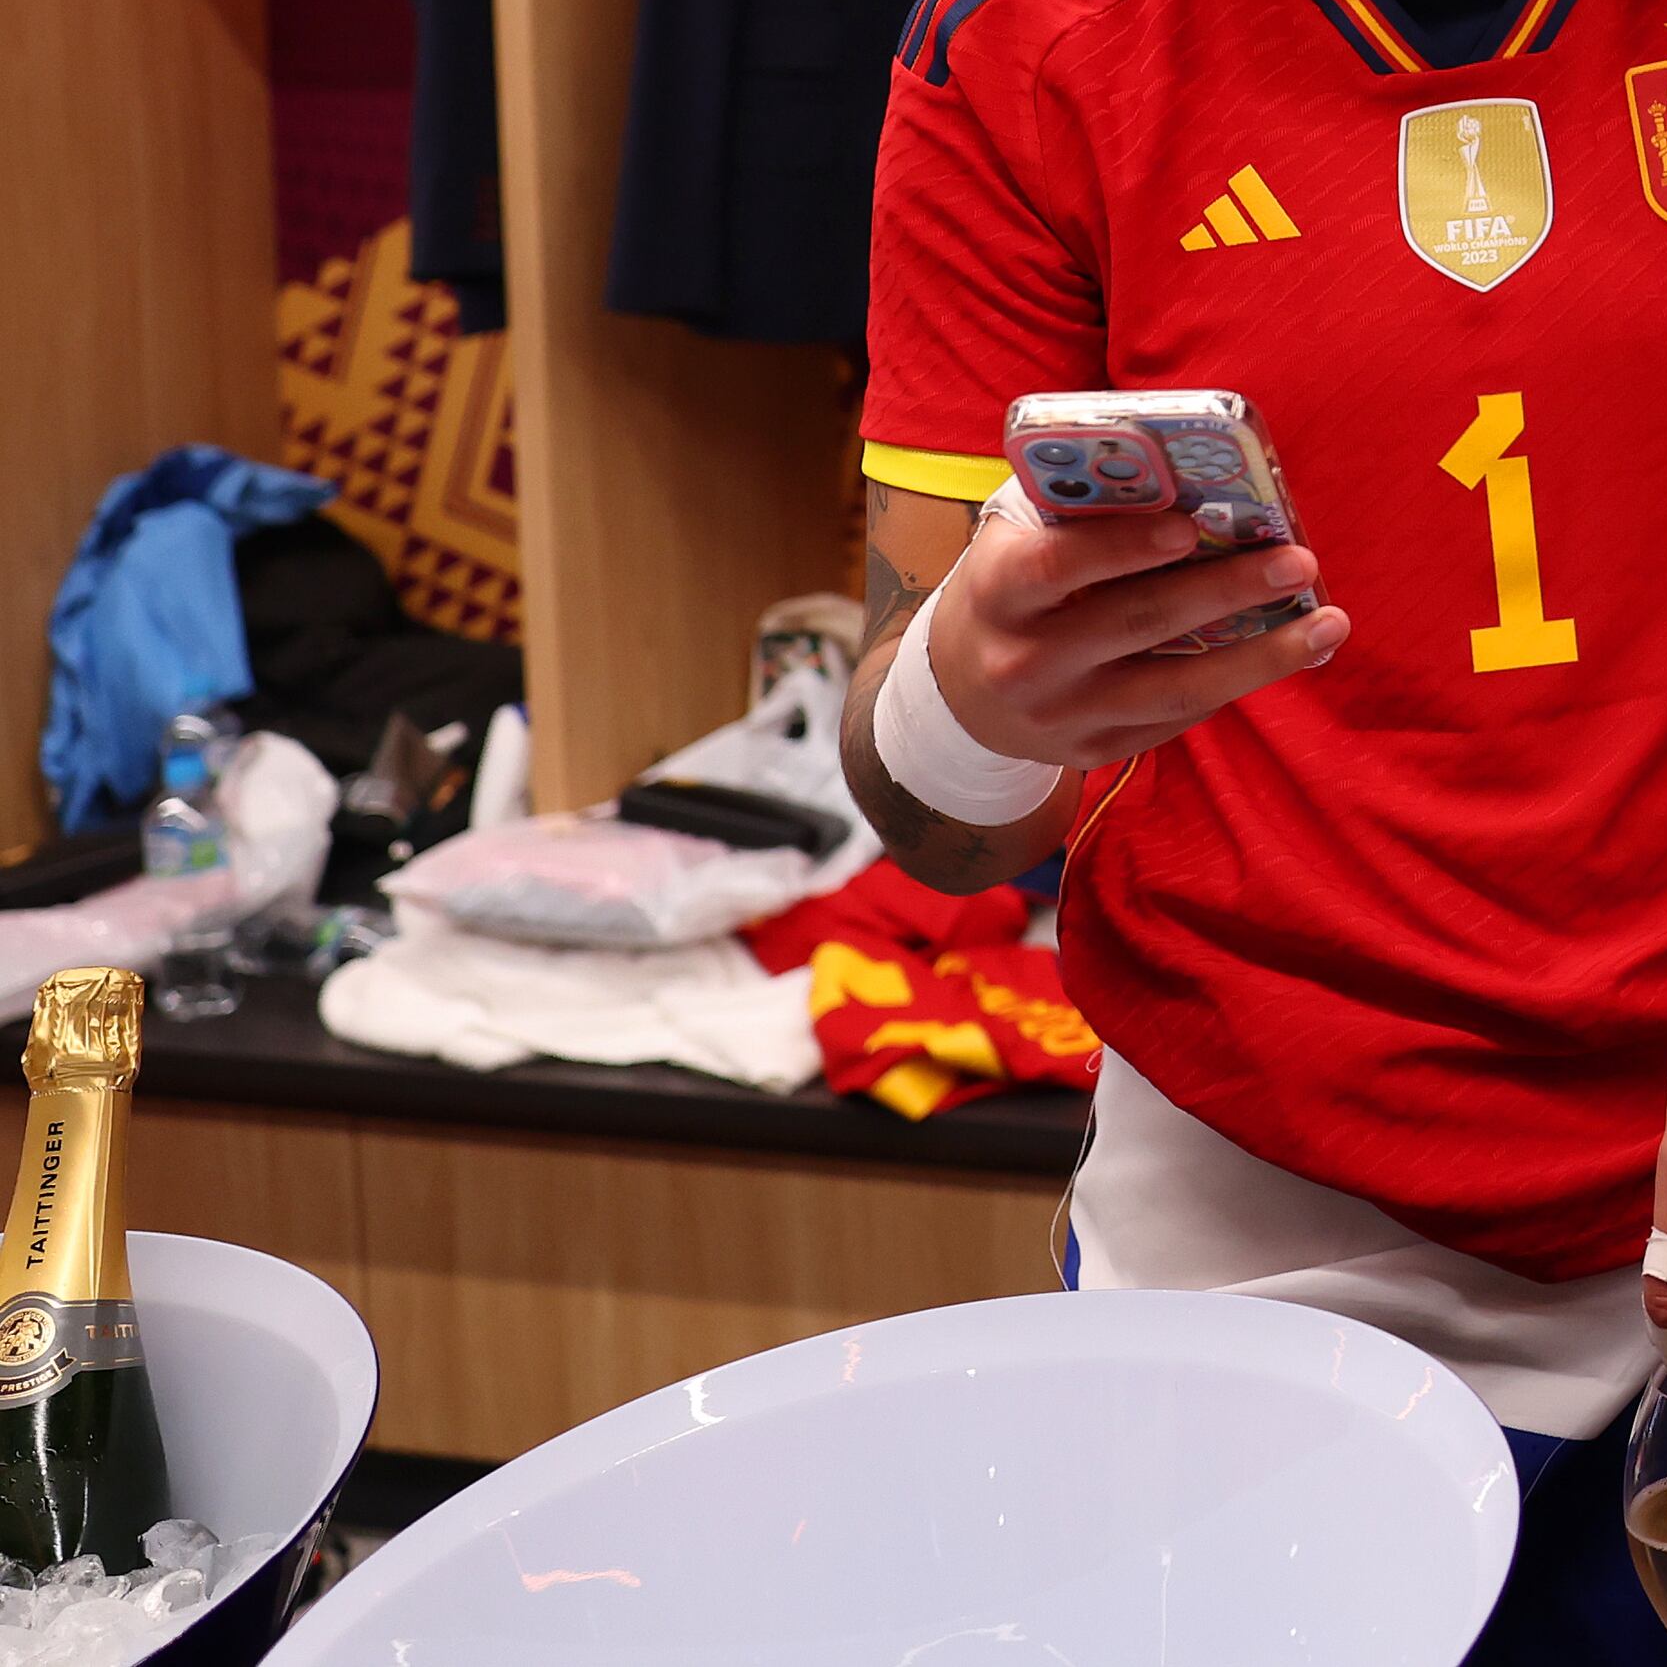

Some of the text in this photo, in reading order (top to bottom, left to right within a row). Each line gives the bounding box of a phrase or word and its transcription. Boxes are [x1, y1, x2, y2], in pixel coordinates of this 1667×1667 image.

[1446, 215, 1512, 242] FIFA
[1434, 237, 1528, 253] WORLD CHAMPIONS
[1461, 249, 1498, 265] 2023
[1437, 391, 1579, 673] 1
[26, 1119, 66, 1270] TAITTINGER
[1, 1370, 55, 1393] PRESTIGE
